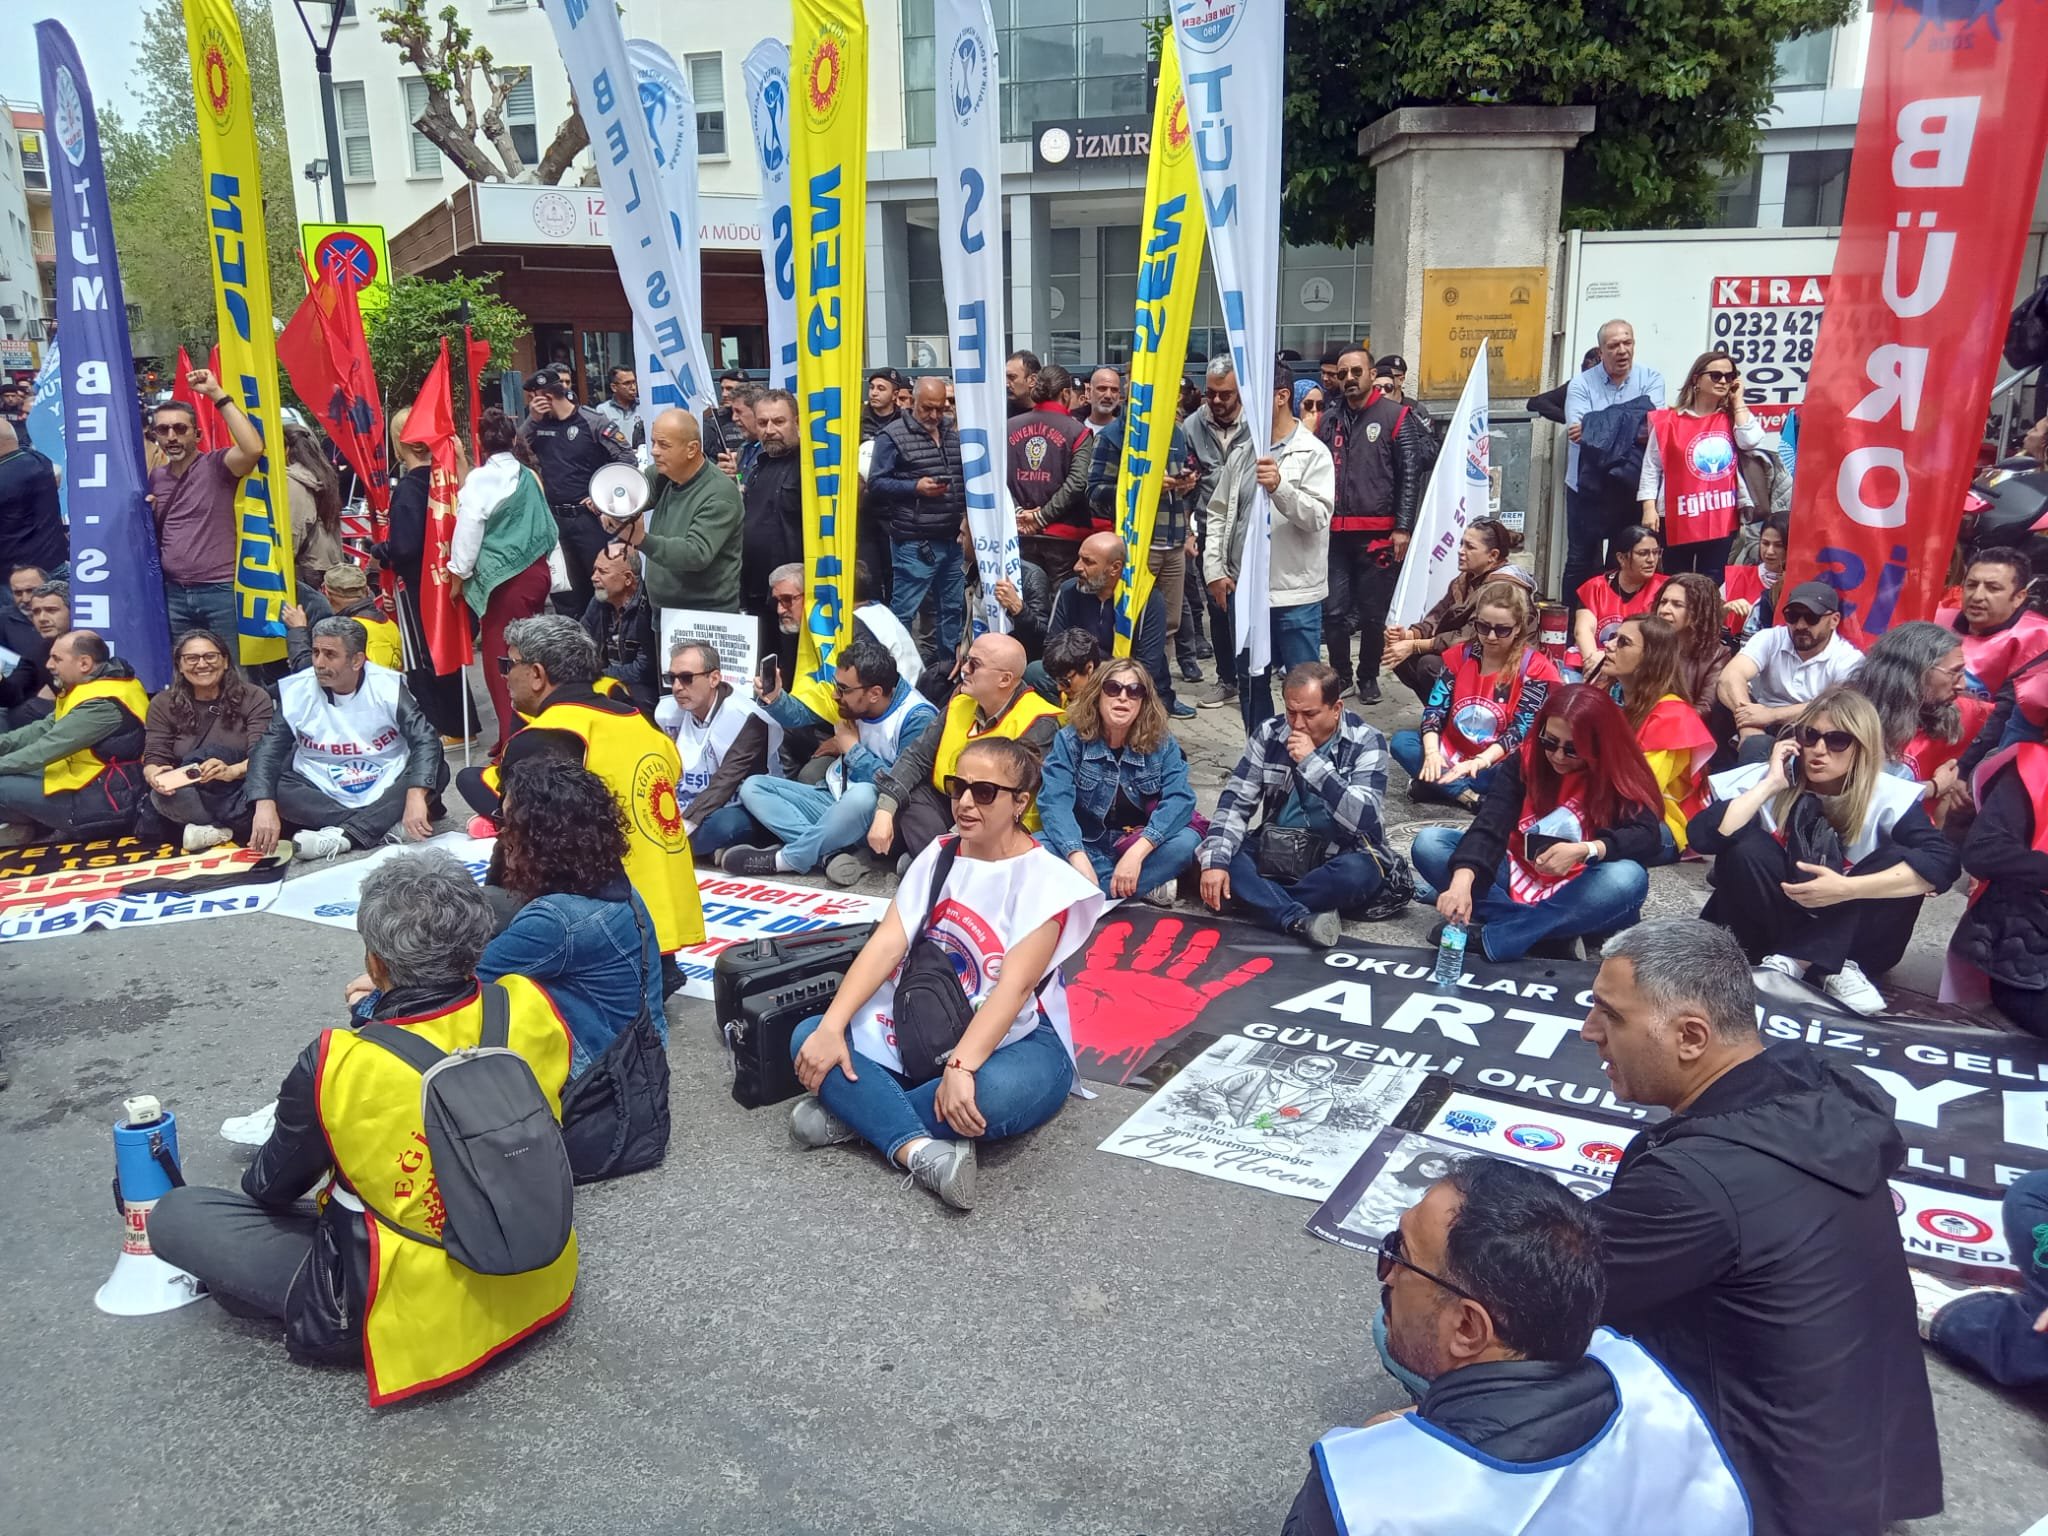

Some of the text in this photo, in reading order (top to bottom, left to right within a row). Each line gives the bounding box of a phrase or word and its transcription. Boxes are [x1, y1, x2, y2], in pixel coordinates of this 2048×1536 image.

[1075, 125, 1151, 158] İZMİR
[587, 196, 607, 216] İZ
[712, 223, 761, 241] MÜDÜ
[1714, 311, 1777, 338] 0232
[1460, 346, 1504, 359] SOAK
[1782, 337, 1814, 363] 28
[331, 743, 362, 755] BEL
[372, 727, 398, 751] SEN
[1270, 979, 1587, 1059] ART
[1242, 1022, 1463, 1077] GÜVENLİ
[1192, 1123, 1225, 1136] 1970
[1118, 1132, 1209, 1159] Ayla
[1162, 1126, 1315, 1168] Seni Unutmayacağız
[394, 1130, 429, 1201] EĞİ
[1901, 1236, 2011, 1264] NFED
